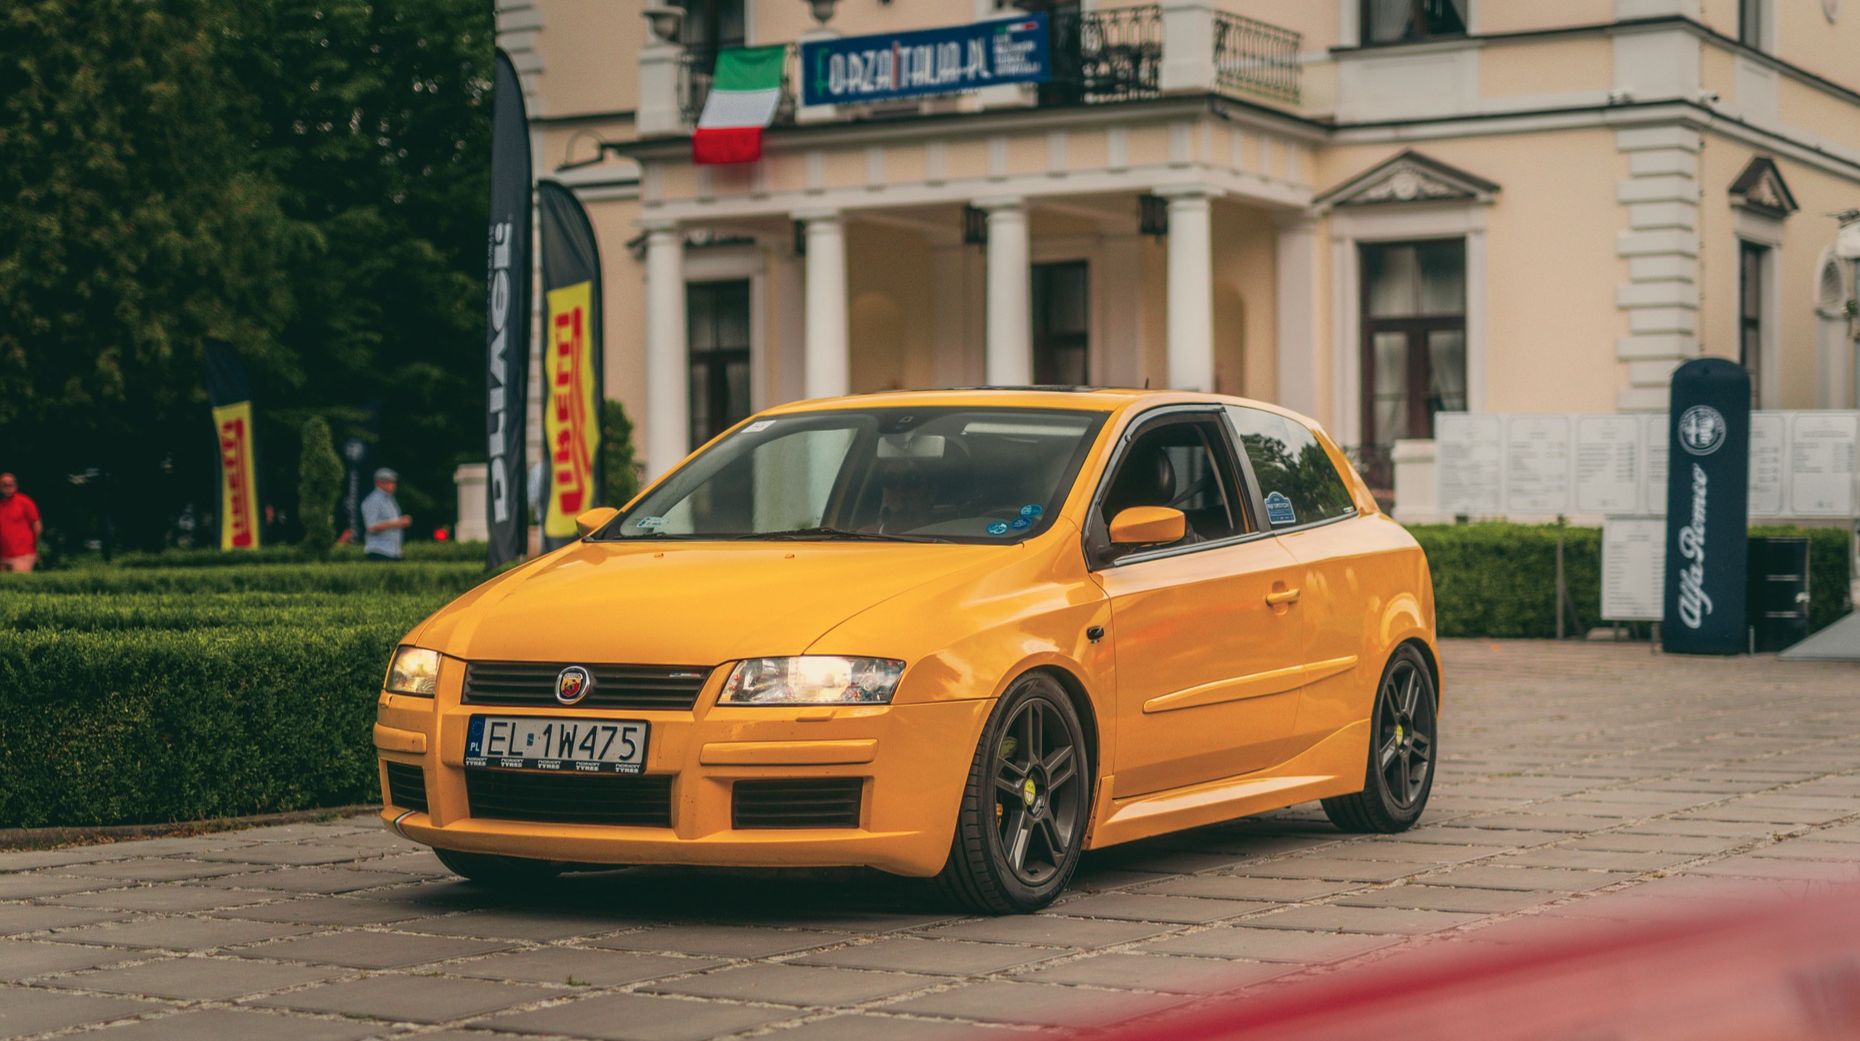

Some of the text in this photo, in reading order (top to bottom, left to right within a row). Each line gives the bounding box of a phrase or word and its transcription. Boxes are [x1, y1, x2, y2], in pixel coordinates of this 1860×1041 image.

[1678, 463, 1708, 565] Romeo
[1678, 563, 1713, 629] Alfa
[470, 742, 480, 752] PL
[487, 722, 637, 761] EL 1W475
